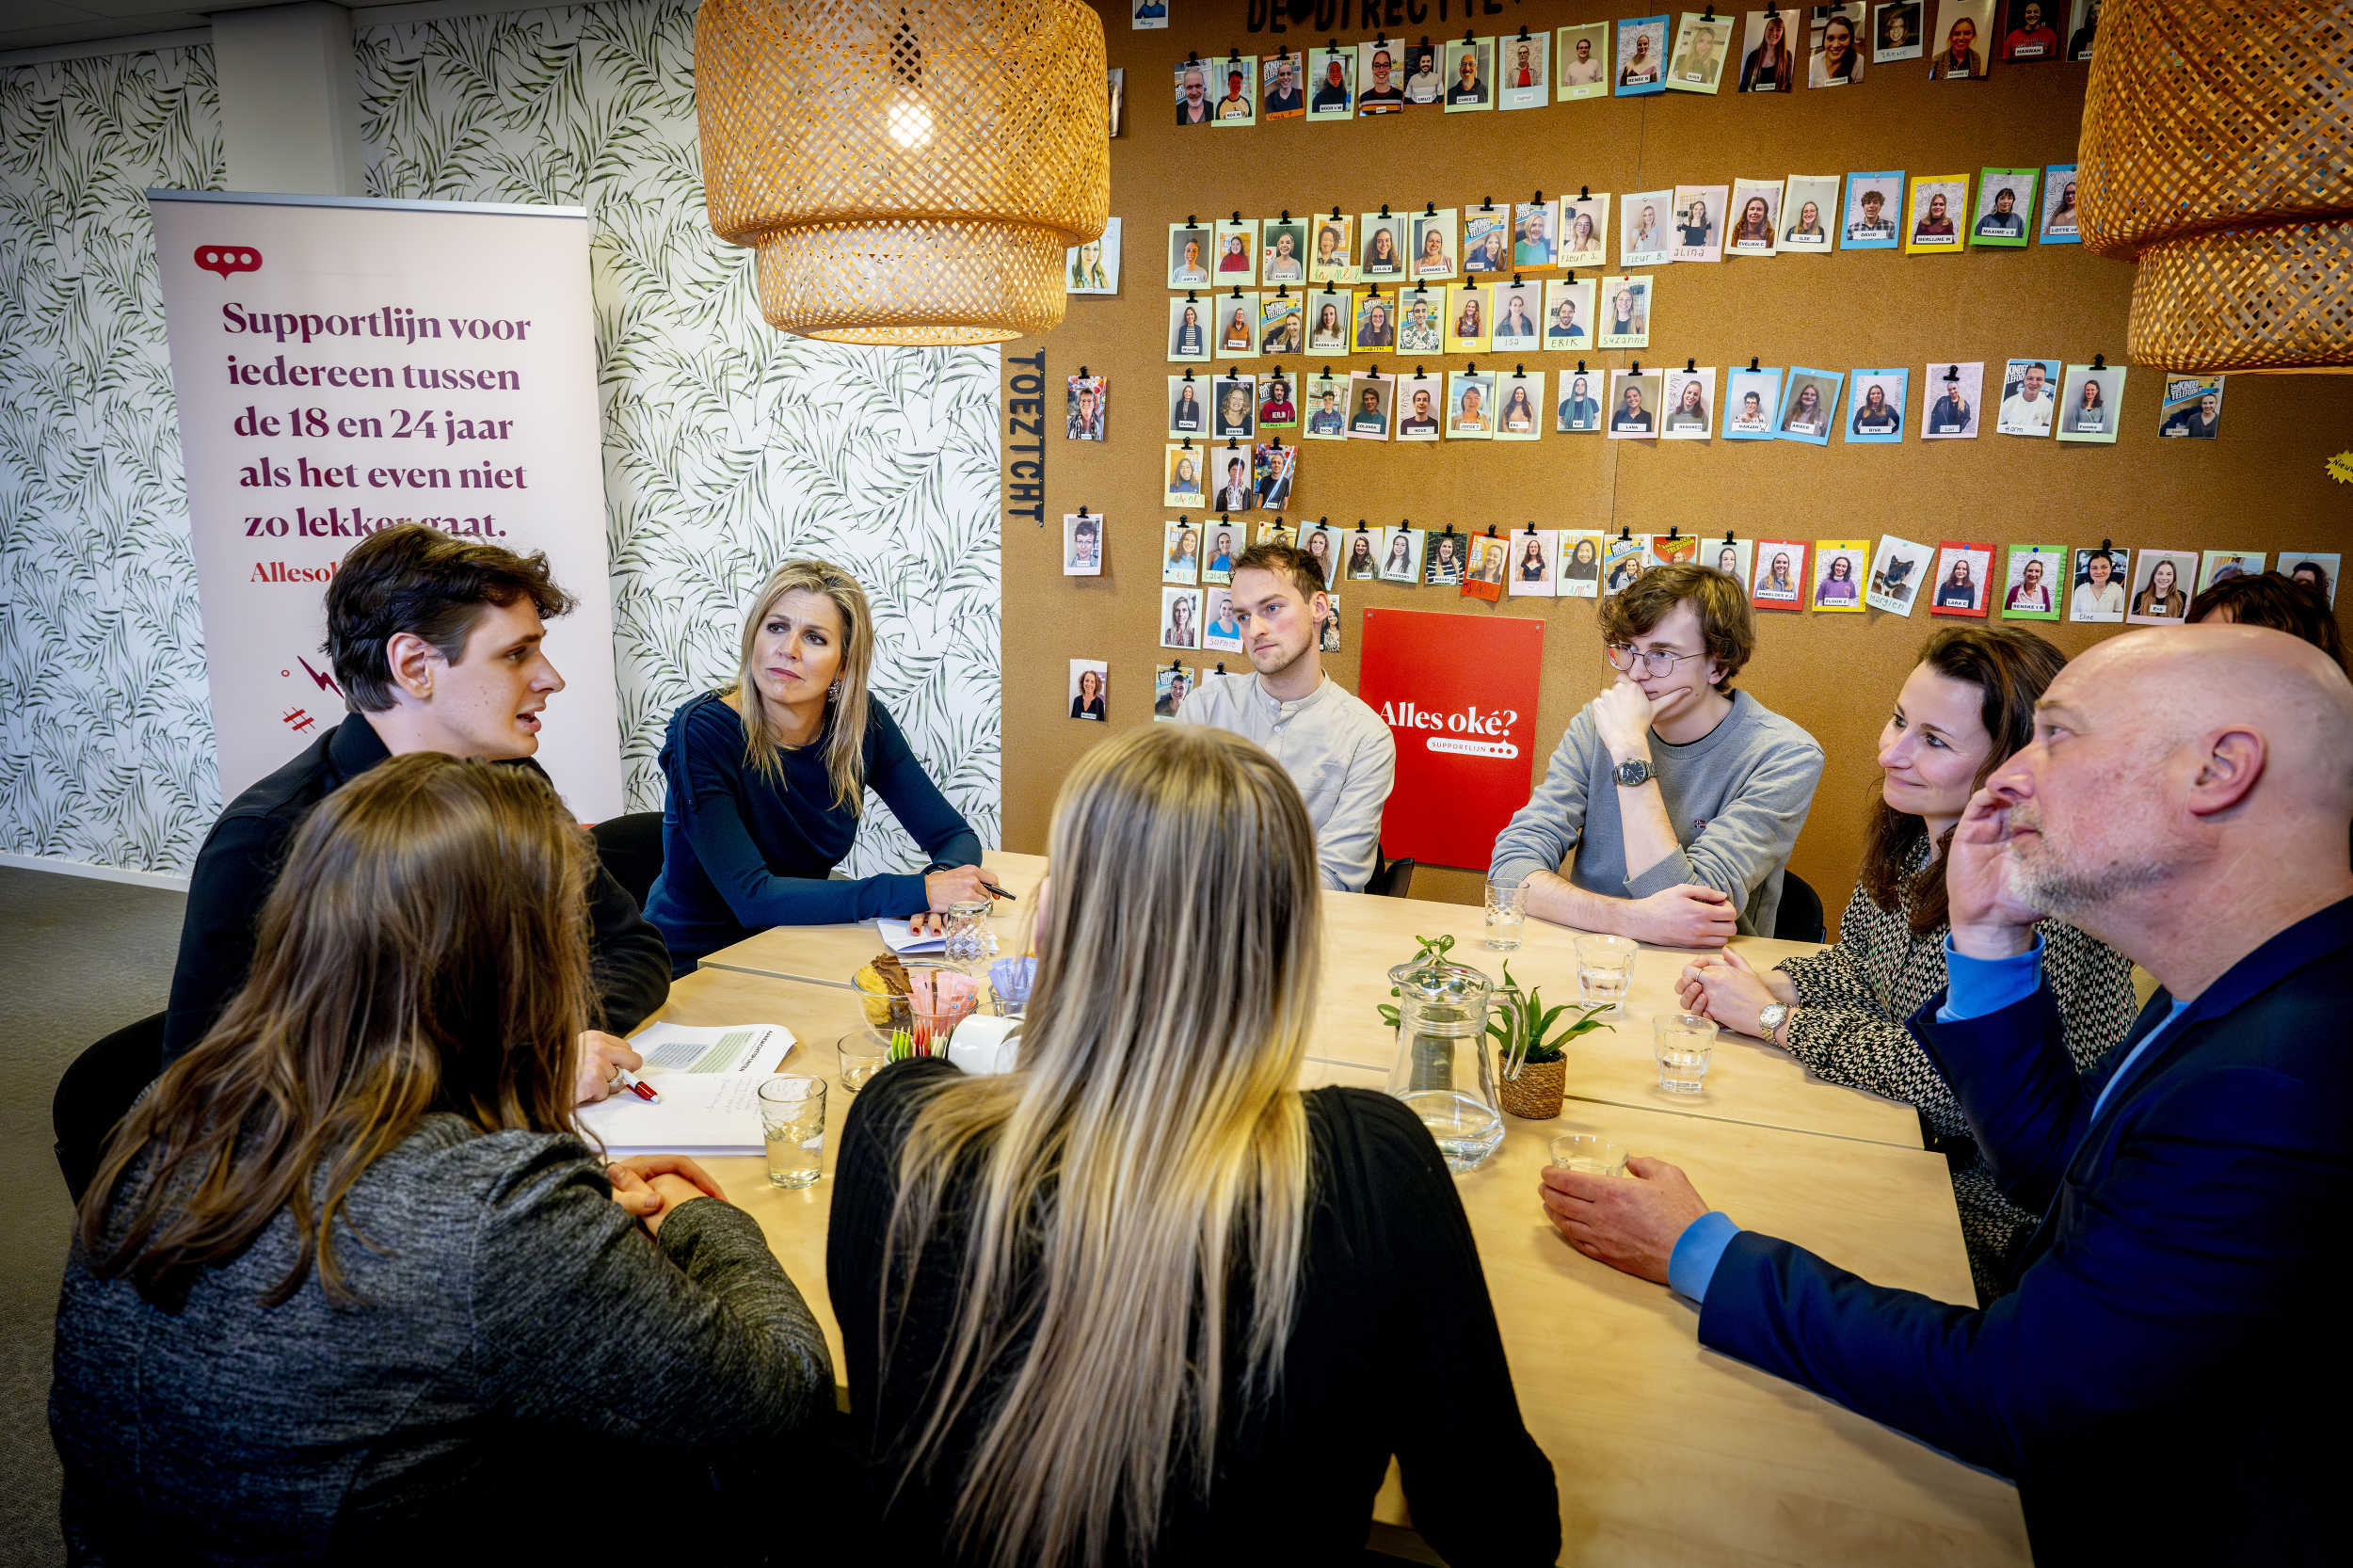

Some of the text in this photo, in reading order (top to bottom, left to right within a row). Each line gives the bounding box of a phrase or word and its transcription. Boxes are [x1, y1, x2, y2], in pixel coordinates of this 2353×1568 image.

[2015, 46, 2041, 55] HANNAH
[222, 302, 531, 345] Supportlijn voor
[1550, 338, 1578, 348] ERIK
[227, 355, 520, 391] iedereen tussen
[233, 406, 514, 446] de 18 en 24 jaar
[1008, 351, 1045, 522] TOEZICHT
[239, 456, 528, 489] als het even niet
[245, 515, 289, 537] zo
[1381, 700, 1518, 736] Alles oké?
[1431, 741, 1487, 753] SUPPORTLIJN
